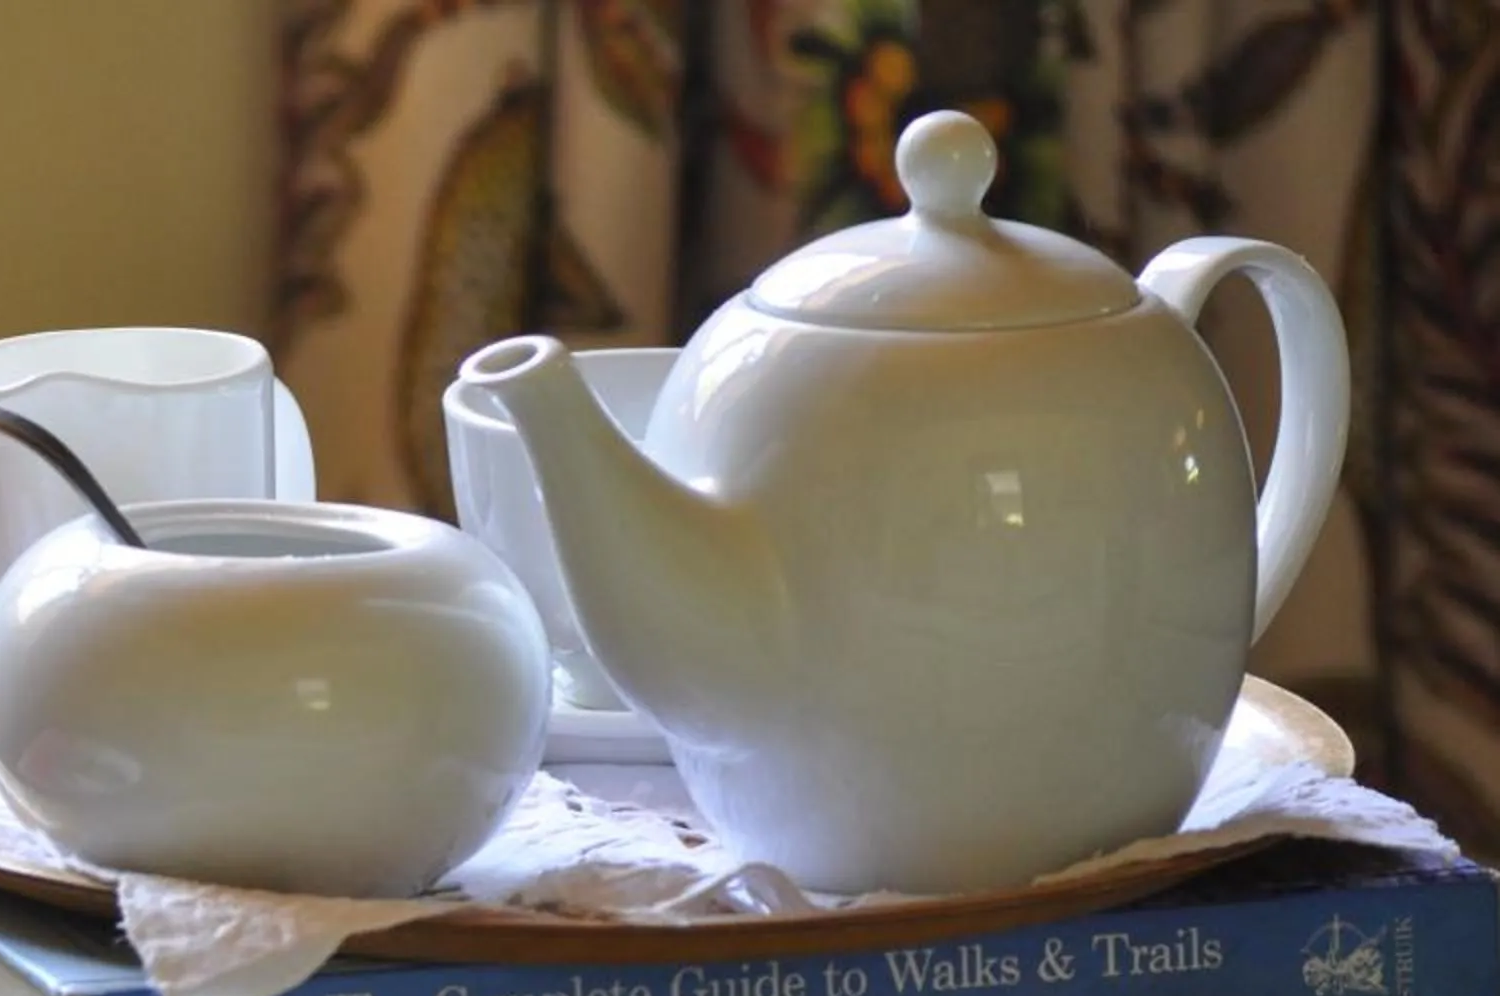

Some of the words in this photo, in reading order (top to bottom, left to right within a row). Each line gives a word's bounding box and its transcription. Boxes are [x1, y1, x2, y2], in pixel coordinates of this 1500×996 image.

[884, 944, 1021, 993] Walks
[1037, 939, 1076, 984] &
[1093, 927, 1223, 977] Trails
